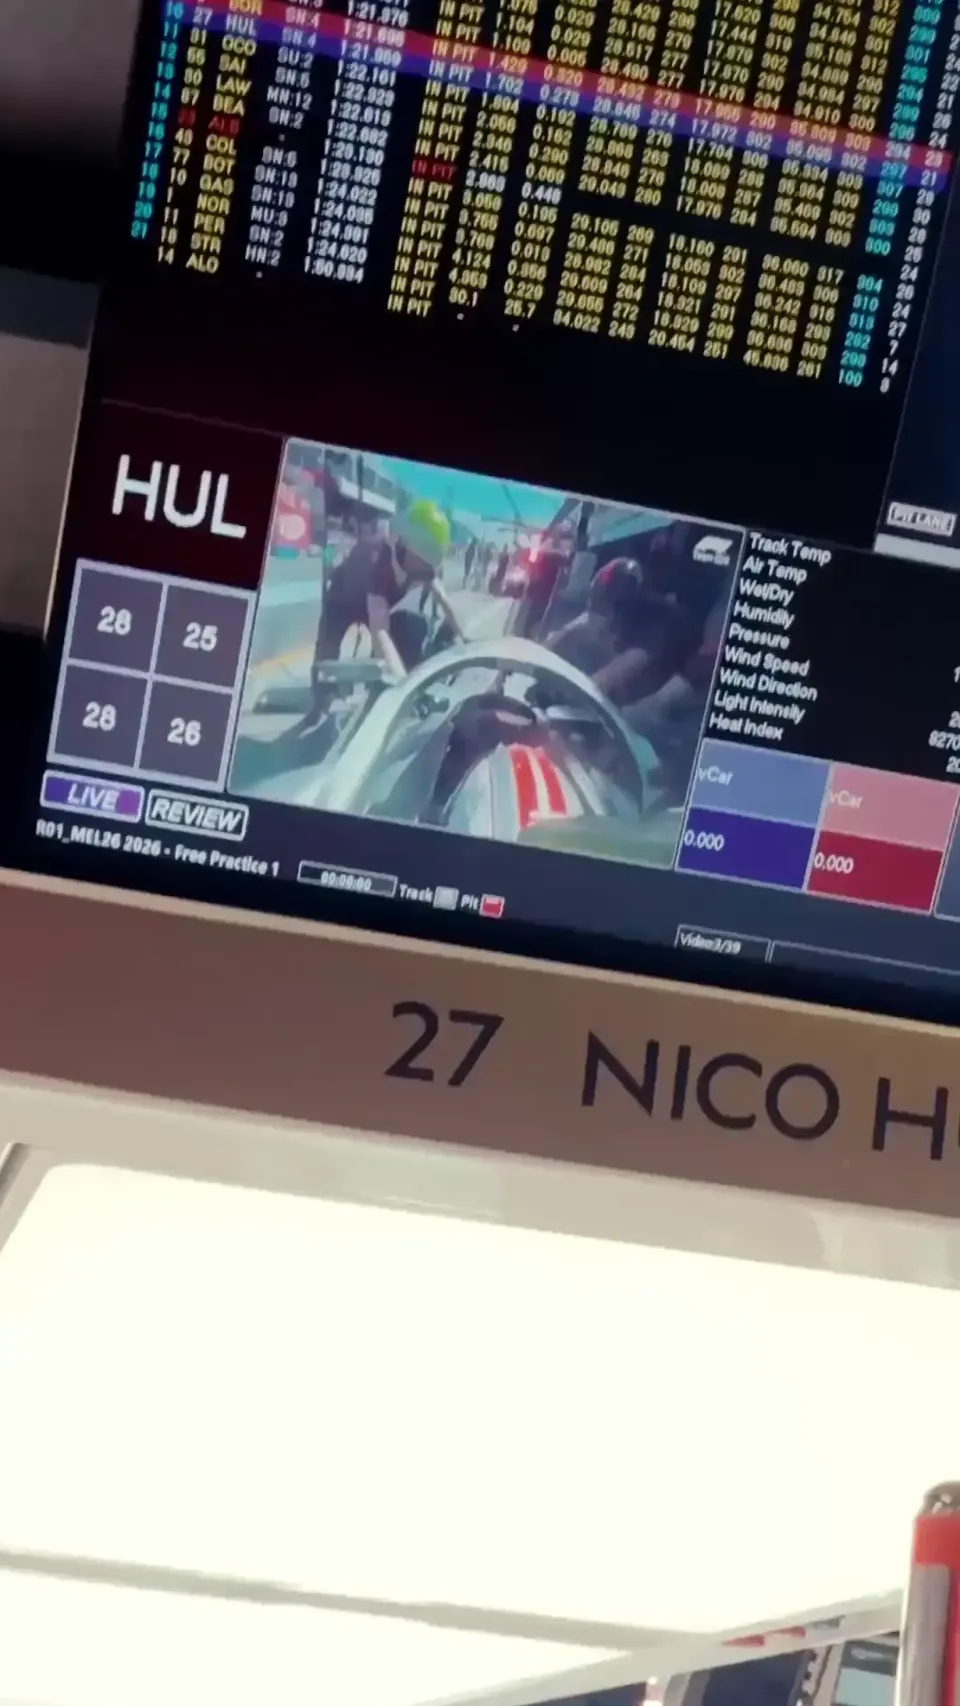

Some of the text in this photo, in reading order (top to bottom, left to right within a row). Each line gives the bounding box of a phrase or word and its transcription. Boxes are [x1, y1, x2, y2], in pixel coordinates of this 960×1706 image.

[440, 0, 455, 16] IN
[460, 4, 483, 23] PIT
[661, 49, 687, 69] 277
[163, 20, 180, 38] 11
[426, 79, 441, 96] IN
[445, 83, 469, 102] PIT
[436, 19, 947, 148] IN PIT 277 24
[194, 6, 212, 24] 27
[226, 14, 259, 35] HUL
[429, 59, 444, 76] IN
[449, 63, 472, 82] PIT
[920, 169, 939, 186] 21
[216, 74, 249, 95] LAW
[419, 118, 434, 135] IN
[438, 123, 462, 141] PIT
[422, 99, 437, 116] IN
[442, 103, 465, 122] PIT
[206, 134, 239, 155] COL
[408, 177, 423, 194] IN
[428, 182, 451, 200] PIT
[415, 138, 430, 155] IN
[435, 142, 458, 161] PIT
[143, 141, 160, 159] 17
[171, 147, 189, 165] 77
[404, 197, 419, 214] IN
[424, 201, 447, 220] PIT
[623, 244, 649, 262] 271
[892, 301, 910, 318] 24
[170, 167, 185, 184] 10
[401, 216, 416, 233] IN
[420, 221, 444, 239] PIT
[888, 320, 906, 337] 27
[196, 193, 229, 214] NOR
[397, 236, 412, 253] IN
[417, 240, 440, 258] PIT
[452, 247, 491, 269] 4.124
[157, 246, 430, 316] 14 ALO IN PIT
[163, 207, 179, 224] 11
[394, 255, 409, 272] IN
[413, 259, 437, 278] PIT
[612, 301, 638, 320] 272
[880, 357, 898, 374] 14
[390, 275, 405, 291] IN
[410, 279, 433, 297] PIT
[900, 264, 918, 280] 24
[112, 454, 247, 538] HUL
[742, 555, 808, 586] Air Temp
[750, 531, 789, 557] Track
[792, 540, 832, 567] Temp
[96, 605, 218, 651] 28 25
[728, 622, 790, 650] Pressure
[733, 600, 795, 630] Humidity
[720, 666, 818, 701] Wind Direction
[725, 644, 810, 677] Wind Speed
[82, 701, 202, 747] 28 26
[709, 711, 784, 741] Heat Index
[714, 689, 806, 725] Light Intensity
[67, 783, 242, 832] LIVE REVIEW
[35, 818, 121, 850] R01_MEL26
[123, 835, 161, 857] 2026
[174, 843, 208, 865] Free
[209, 850, 268, 876] Practice
[271, 860, 280, 877] 1
[683, 829, 854, 874] 0.000 0.000
[399, 883, 434, 903] Track
[383, 1000, 960, 1162] 27 NICO H
